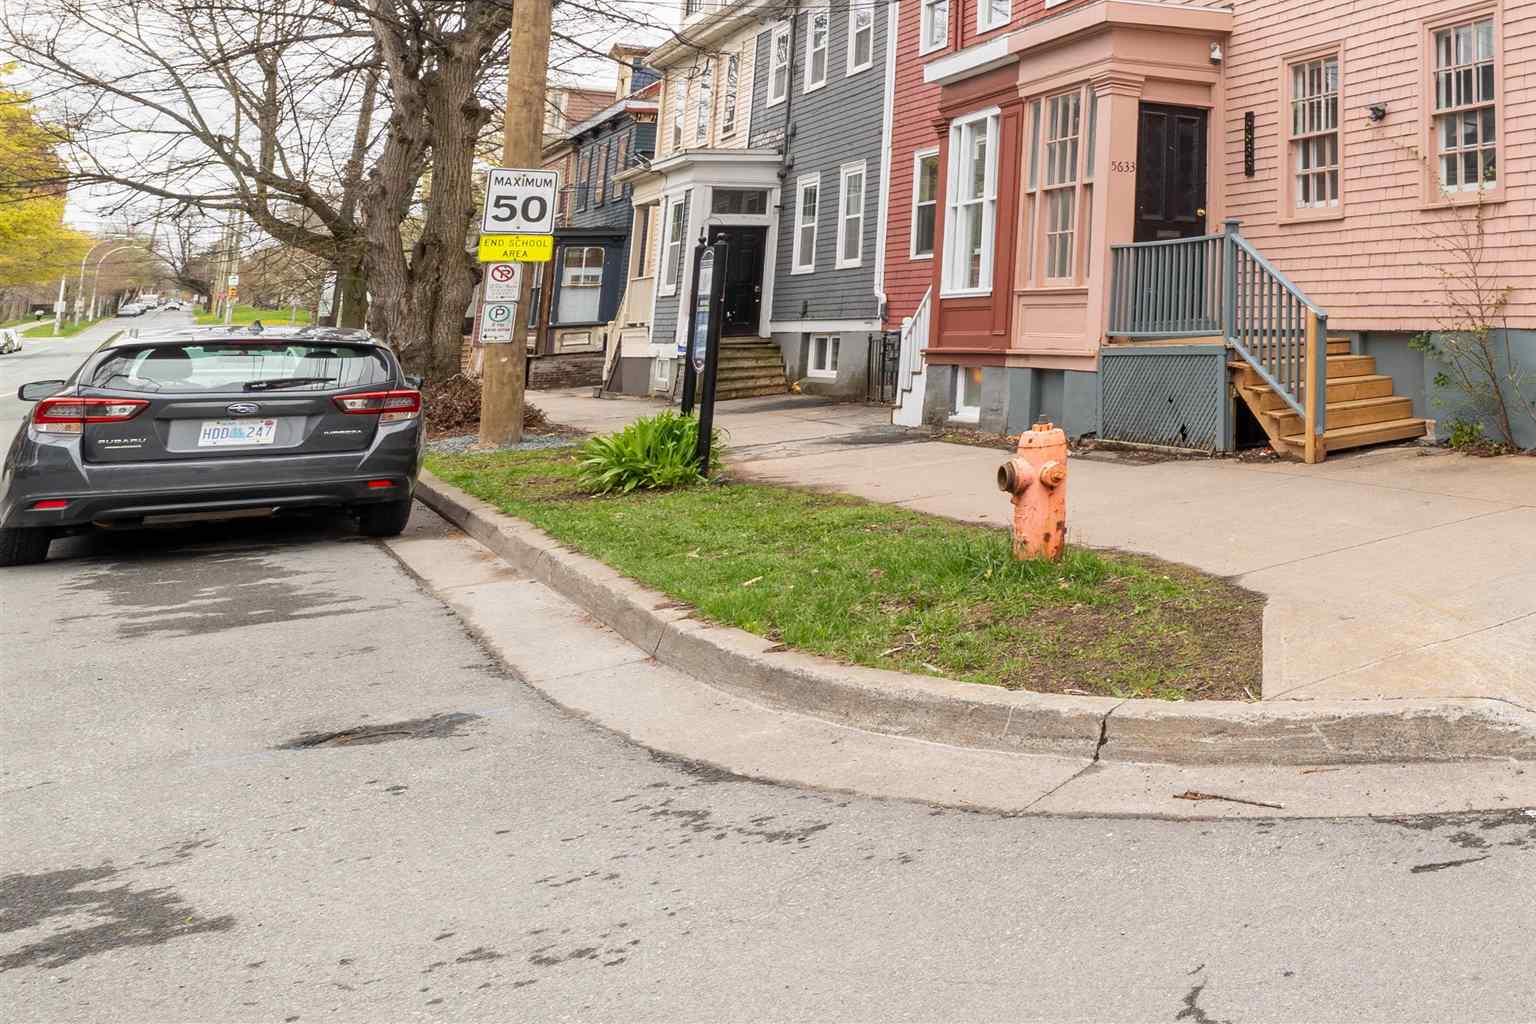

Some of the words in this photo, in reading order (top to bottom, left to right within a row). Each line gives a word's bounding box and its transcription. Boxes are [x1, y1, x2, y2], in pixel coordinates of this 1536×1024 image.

[1112, 160, 1135, 173] 5633
[494, 176, 552, 188] MAXIMUM
[491, 195, 547, 223] 50
[484, 239, 505, 247] END
[508, 239, 548, 248] SCHOOL
[502, 249, 528, 257] AREA
[246, 426, 272, 438] 247
